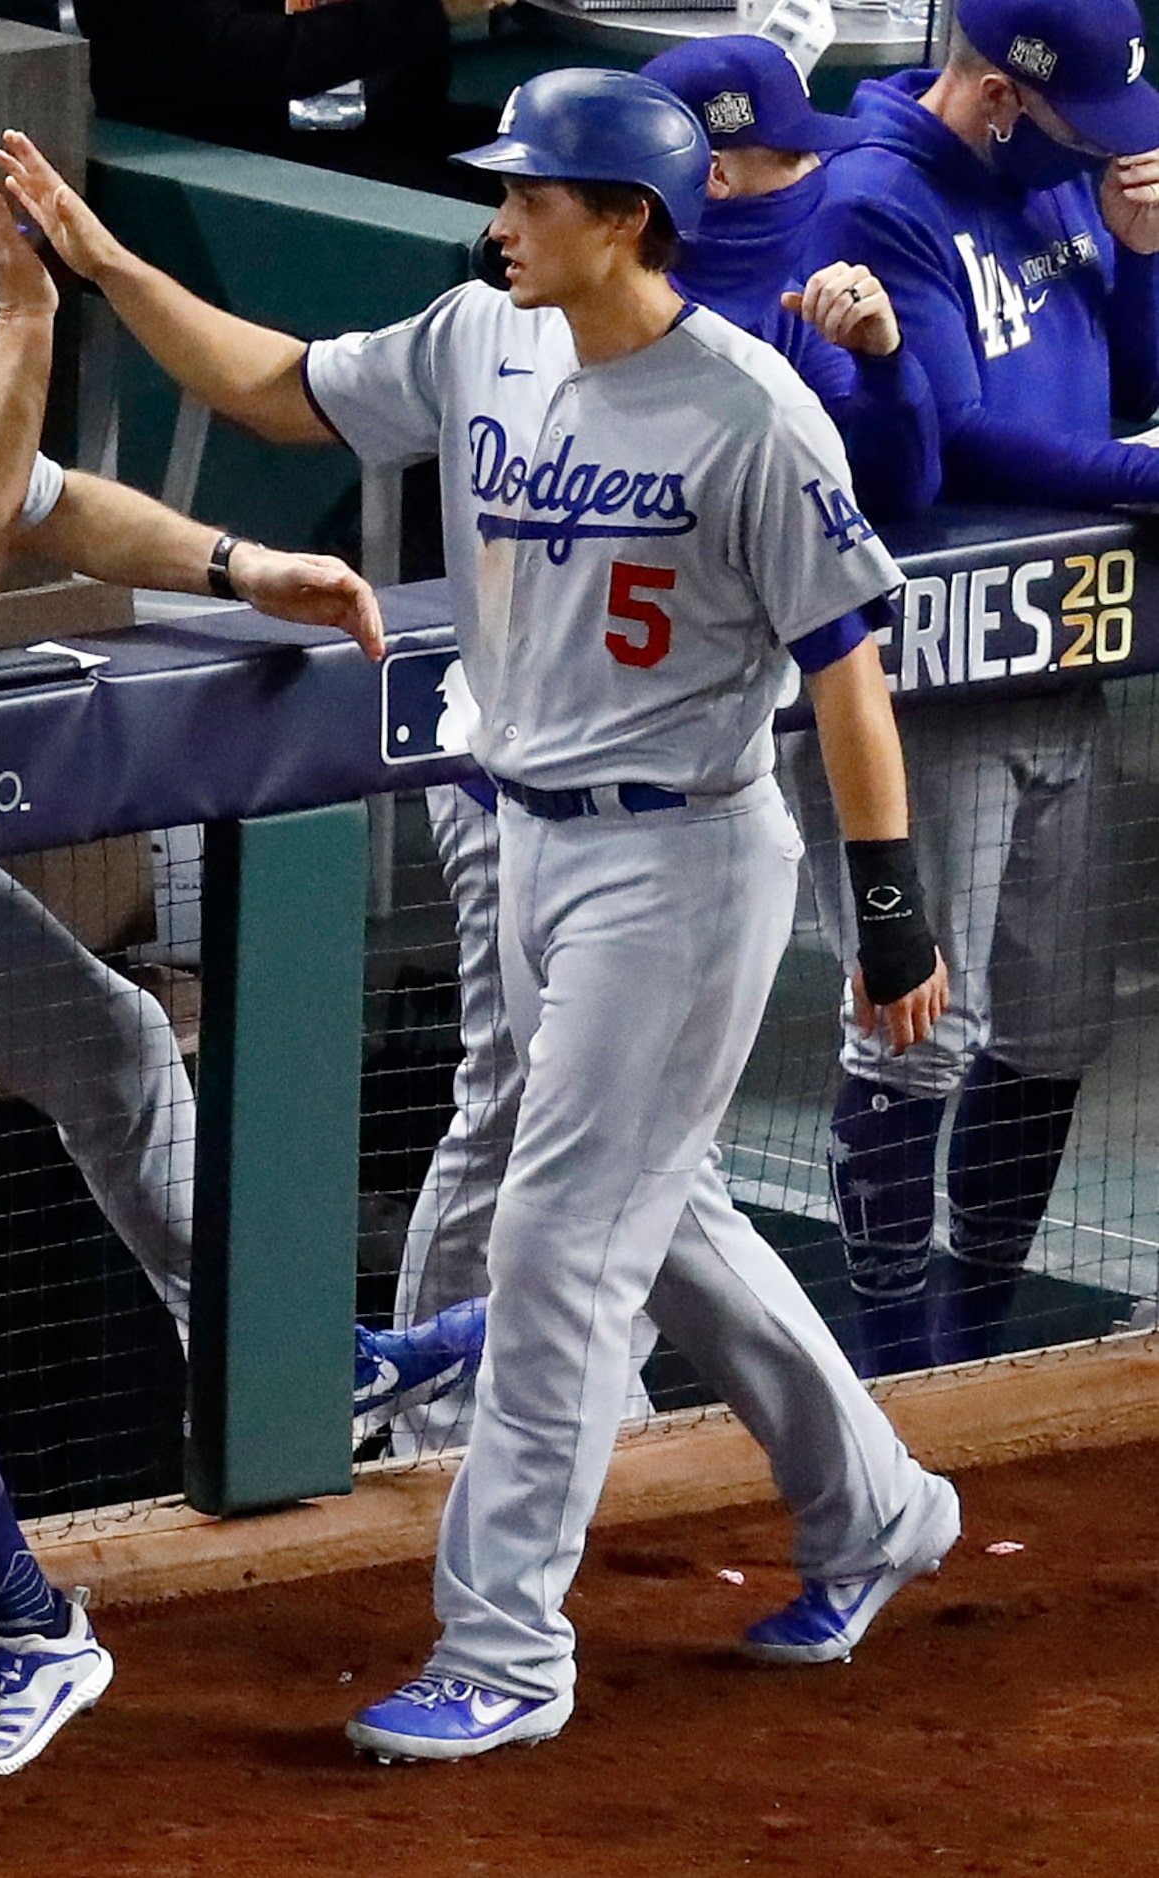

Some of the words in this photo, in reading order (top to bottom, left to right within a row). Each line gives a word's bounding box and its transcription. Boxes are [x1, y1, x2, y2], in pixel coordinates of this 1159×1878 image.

[708, 97, 747, 116] WORLD
[710, 109, 749, 128] SERIES
[468, 415, 697, 565] Dodgers
[801, 479, 877, 553] LA
[1061, 549, 1136, 611] 20
[604, 561, 676, 669] 5
[1059, 606, 1134, 668] 20
